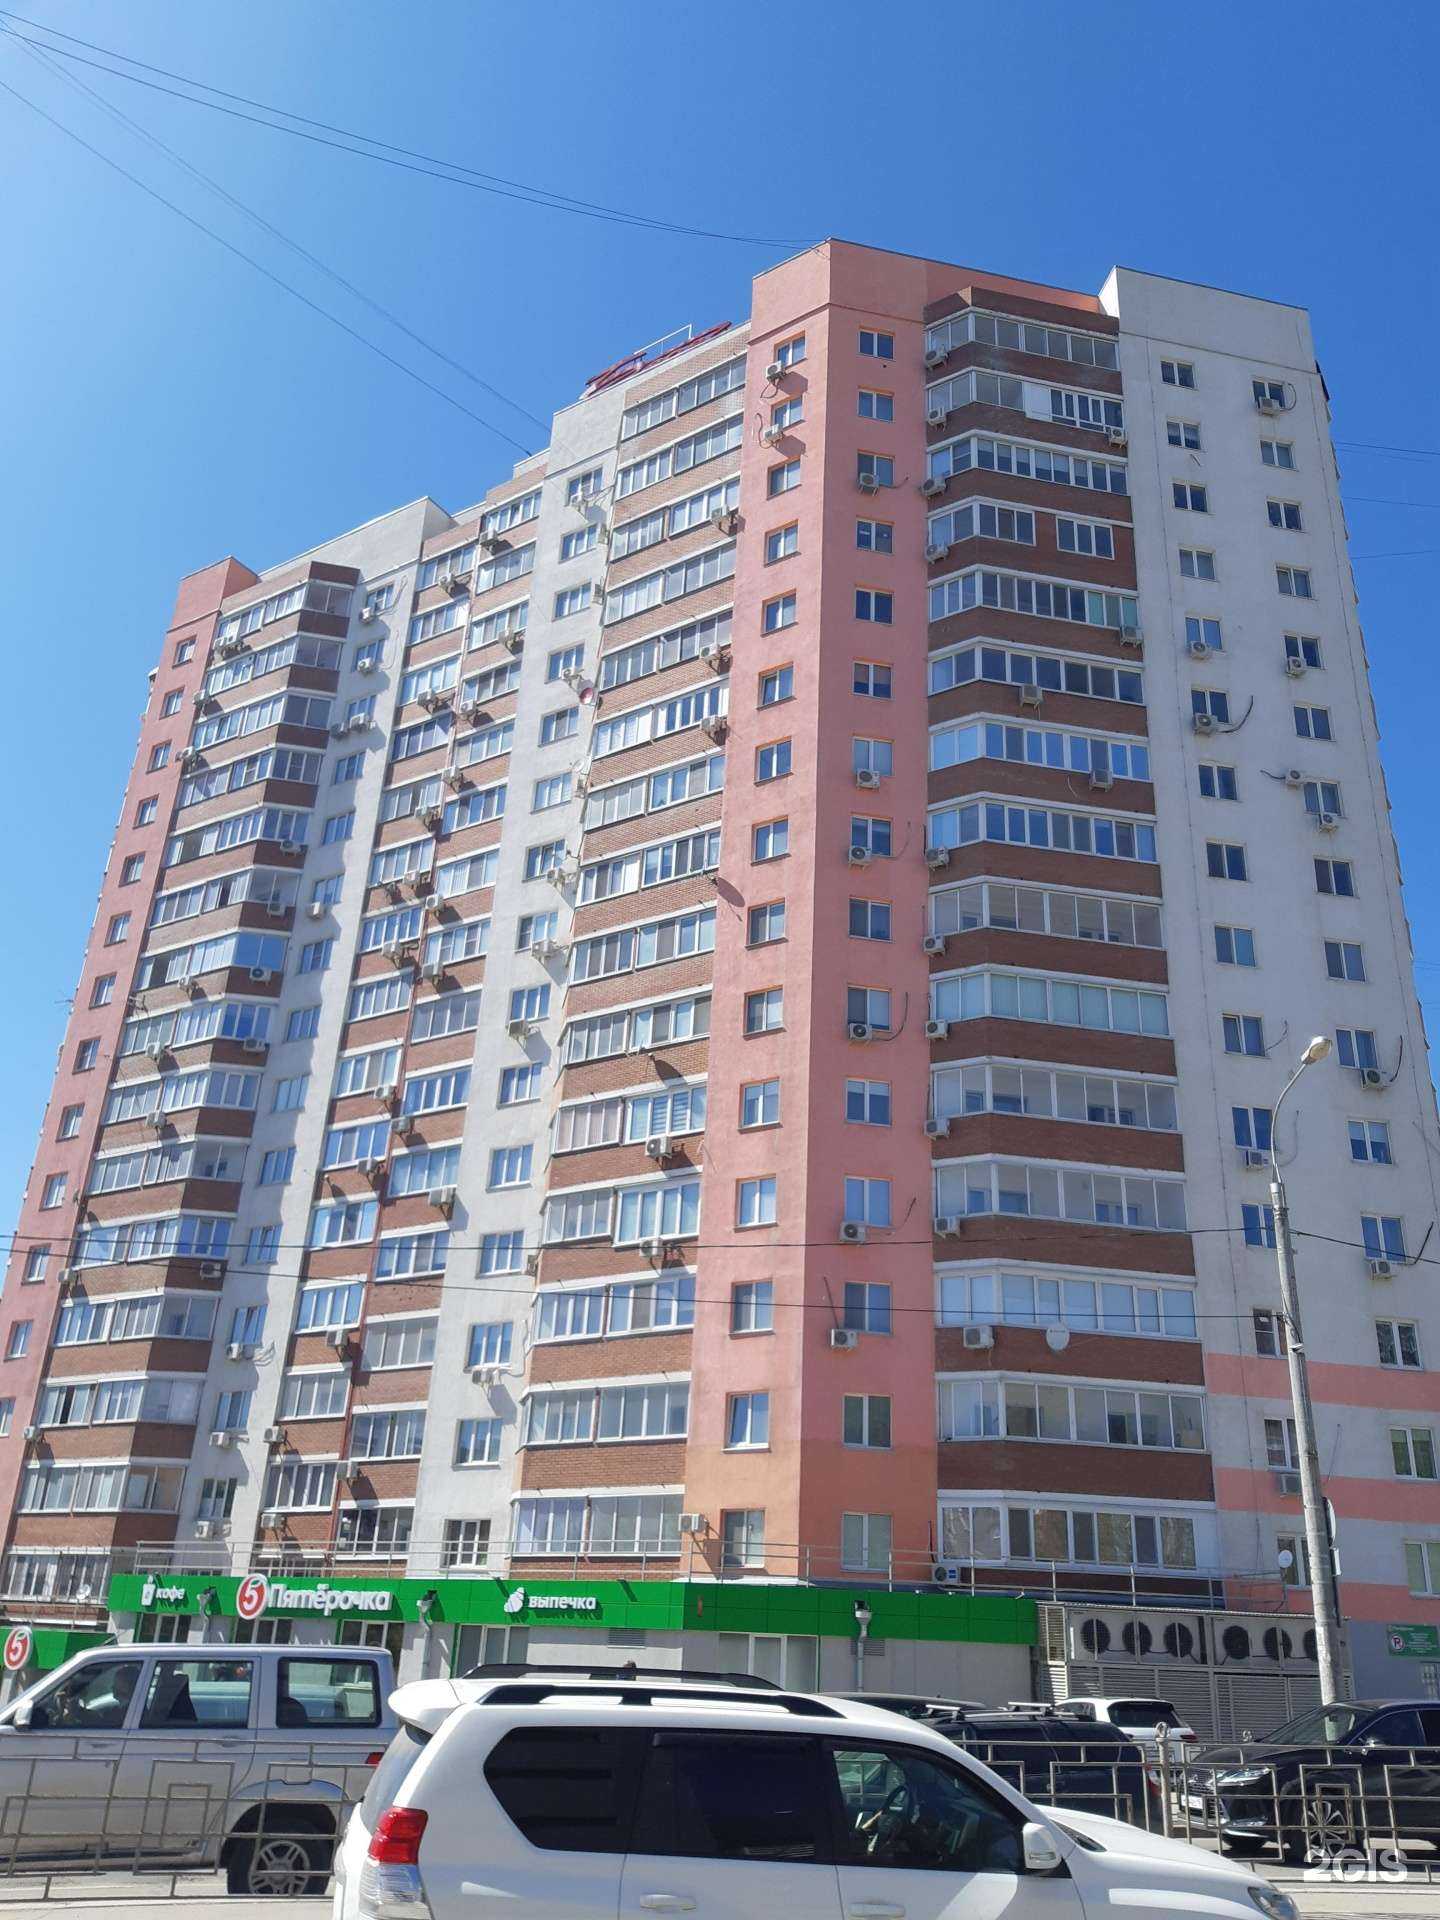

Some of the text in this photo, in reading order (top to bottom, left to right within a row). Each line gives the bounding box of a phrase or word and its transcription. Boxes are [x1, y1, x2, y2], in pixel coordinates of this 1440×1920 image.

[156, 1586, 185, 1602] кофе
[269, 1584, 392, 1616] Пятёрочка
[528, 1596, 597, 1610] выпечка
